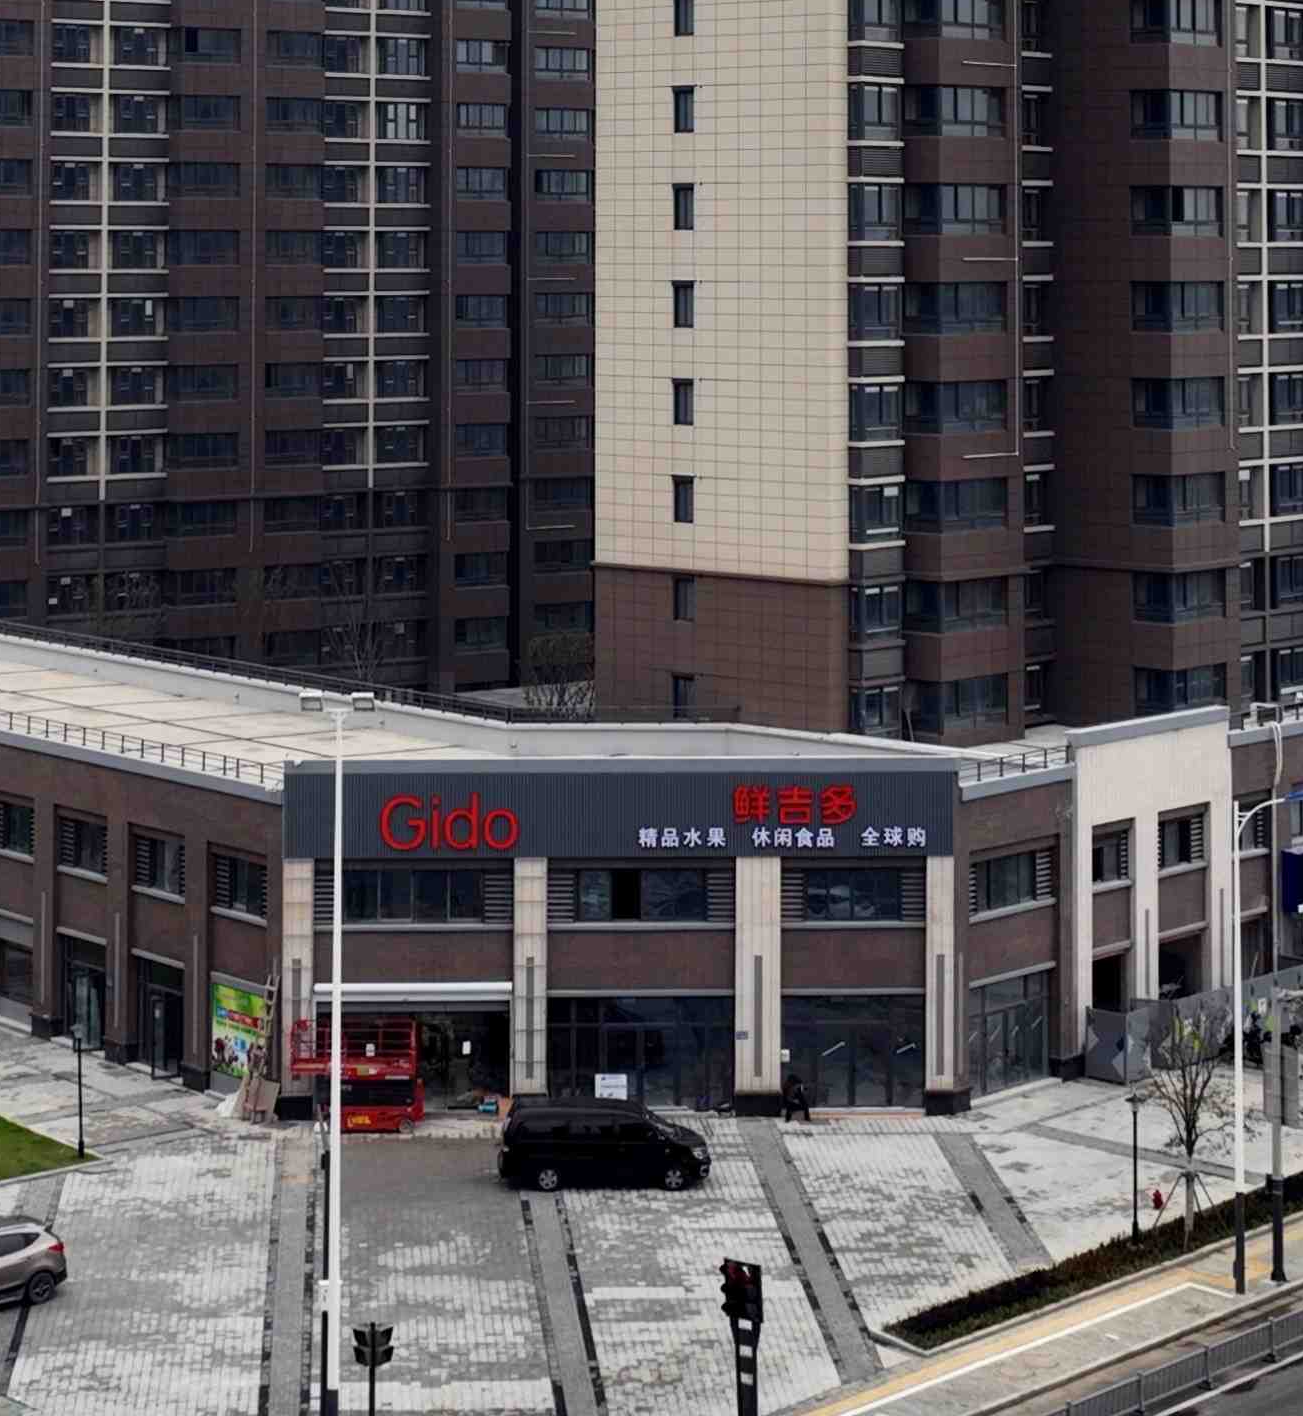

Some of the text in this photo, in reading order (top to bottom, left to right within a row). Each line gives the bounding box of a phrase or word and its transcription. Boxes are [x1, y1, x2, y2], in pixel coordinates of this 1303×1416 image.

[379, 792, 520, 851] Gido
[733, 784, 857, 824] 鲜吉多
[638, 827, 927, 848] 精品水果 休闲食品 全球购
